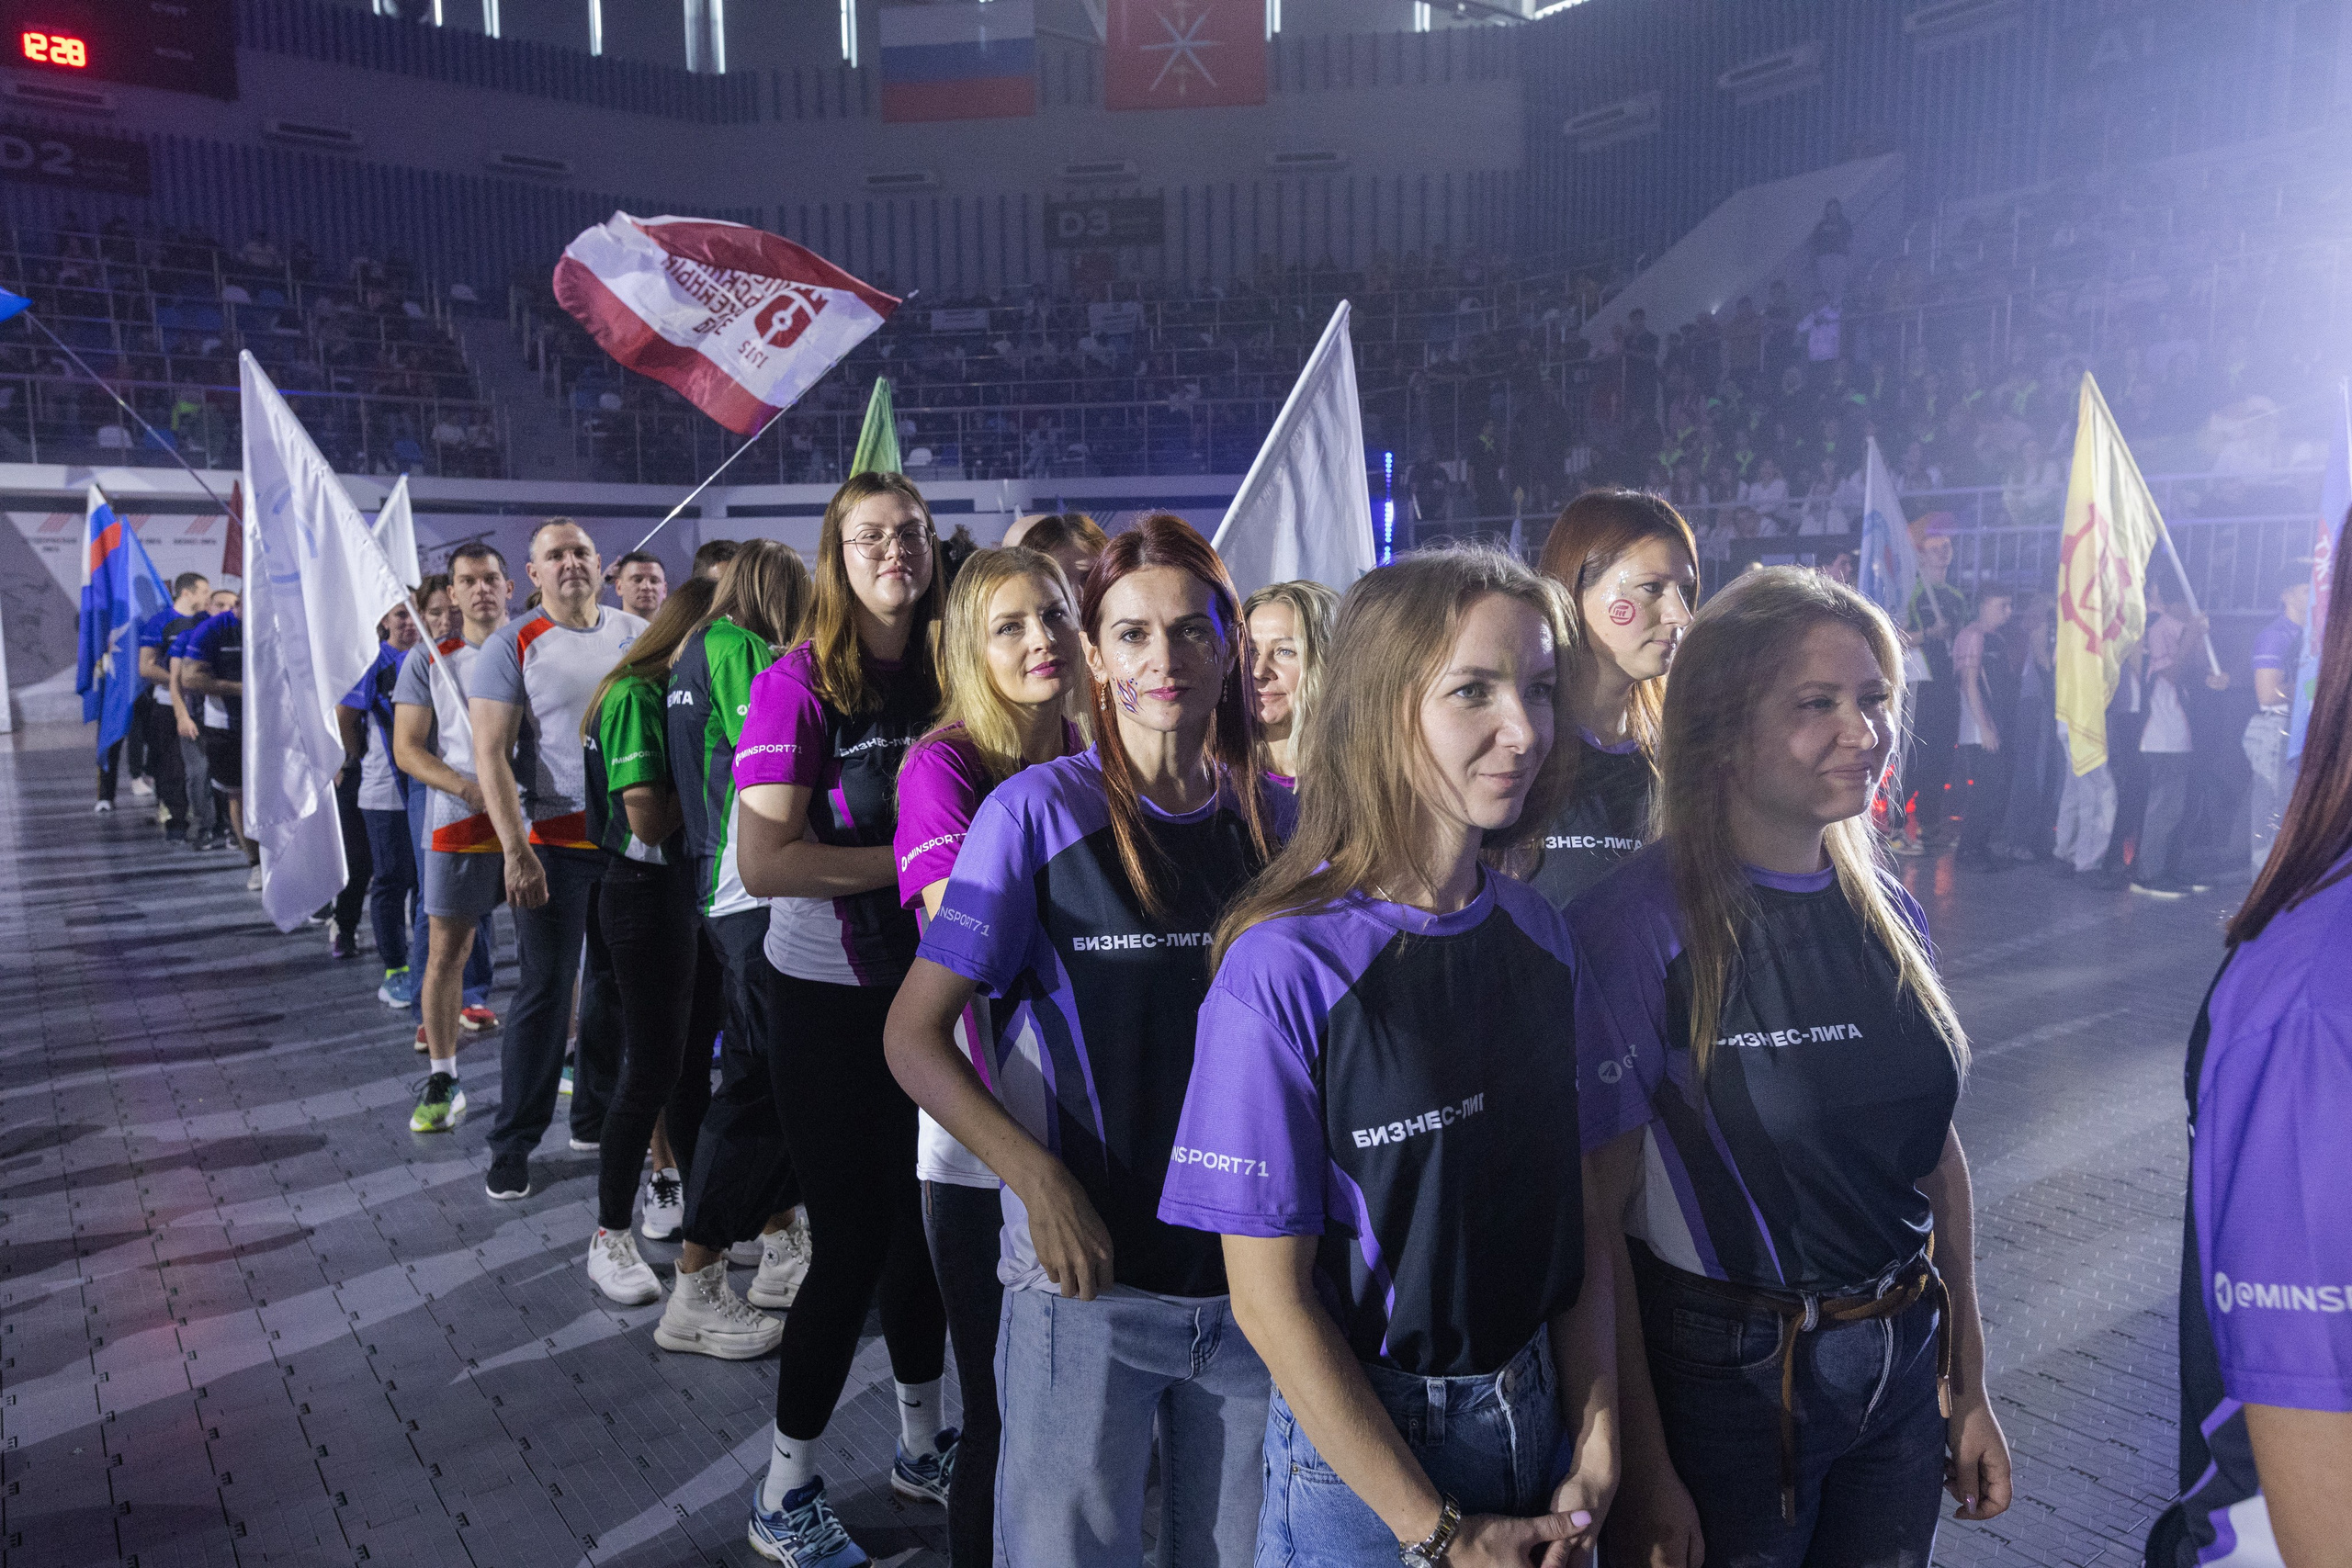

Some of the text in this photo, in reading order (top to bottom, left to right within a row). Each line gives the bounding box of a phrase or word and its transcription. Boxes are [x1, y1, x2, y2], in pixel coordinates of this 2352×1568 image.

[0, 135, 74, 176] D2
[1058, 207, 1110, 238] D3
[908, 832, 967, 864] @MINSPORT
[1072, 932, 1215, 951] БИЗНЕС-ЛИГА
[1351, 1092, 1485, 1148] БИЗНЕС-ЛИГ
